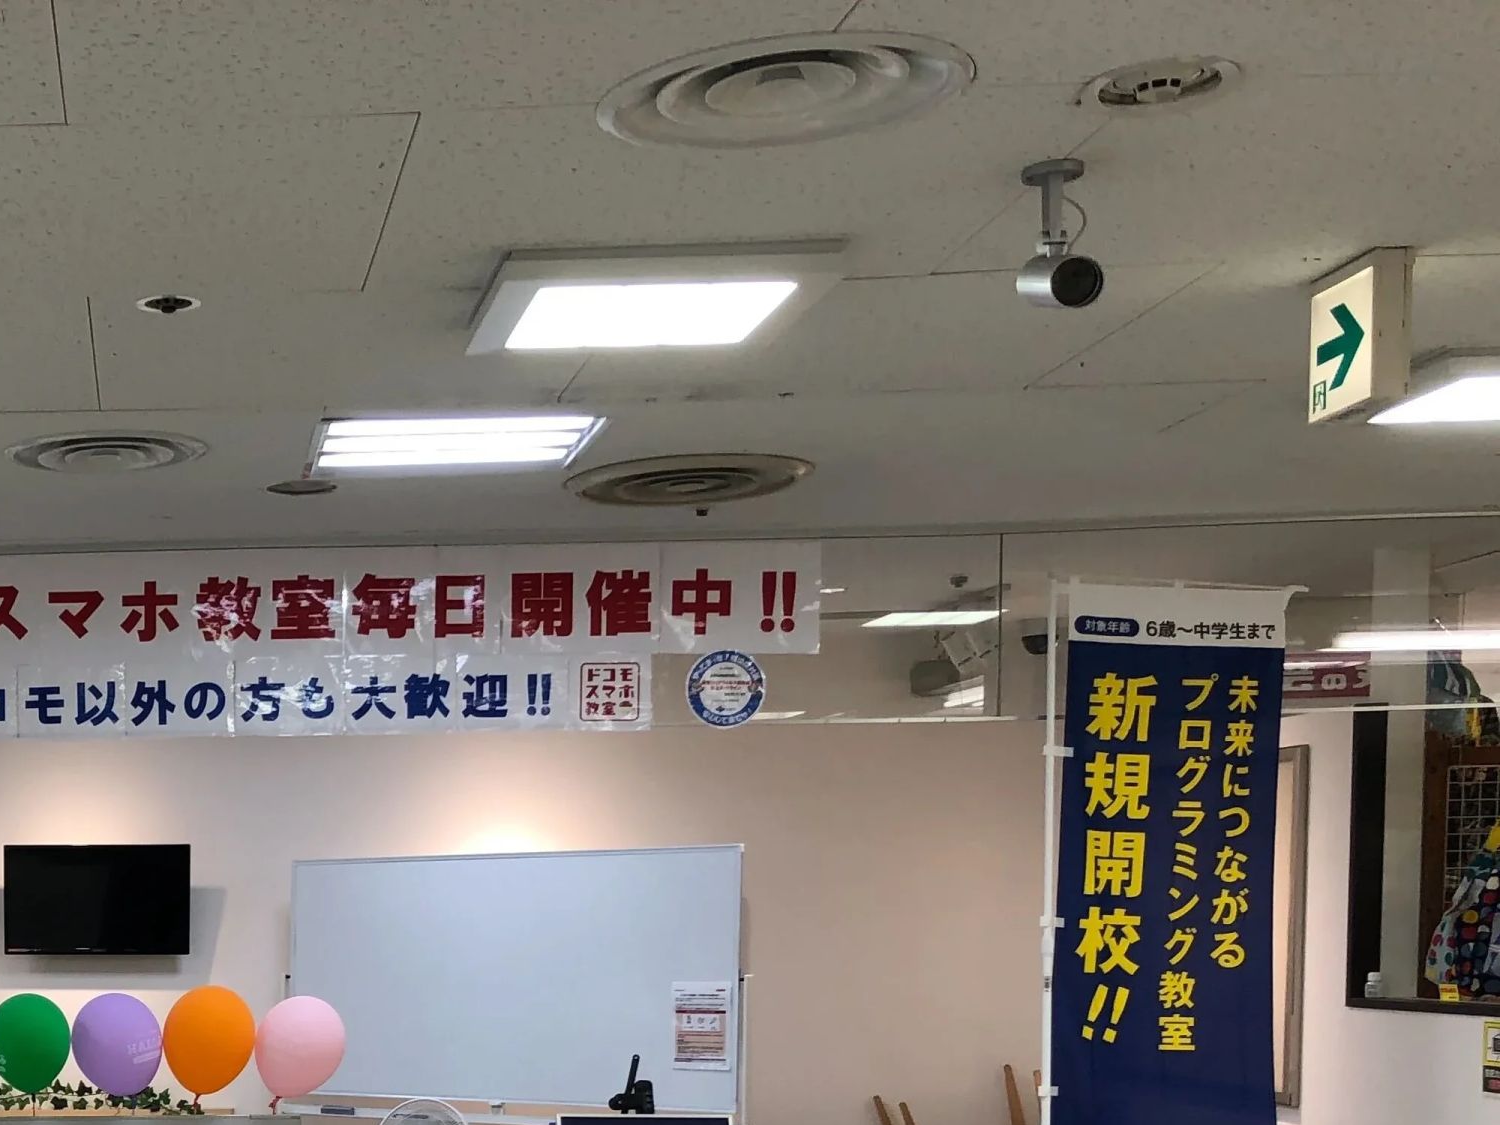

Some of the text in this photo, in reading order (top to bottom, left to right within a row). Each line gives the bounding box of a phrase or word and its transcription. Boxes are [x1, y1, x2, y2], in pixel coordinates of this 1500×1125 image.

[1084, 619, 1131, 634] 対象年齢
[1157, 673, 1219, 1051] プログラミング教室
[1209, 675, 1260, 969] 未来につながる
